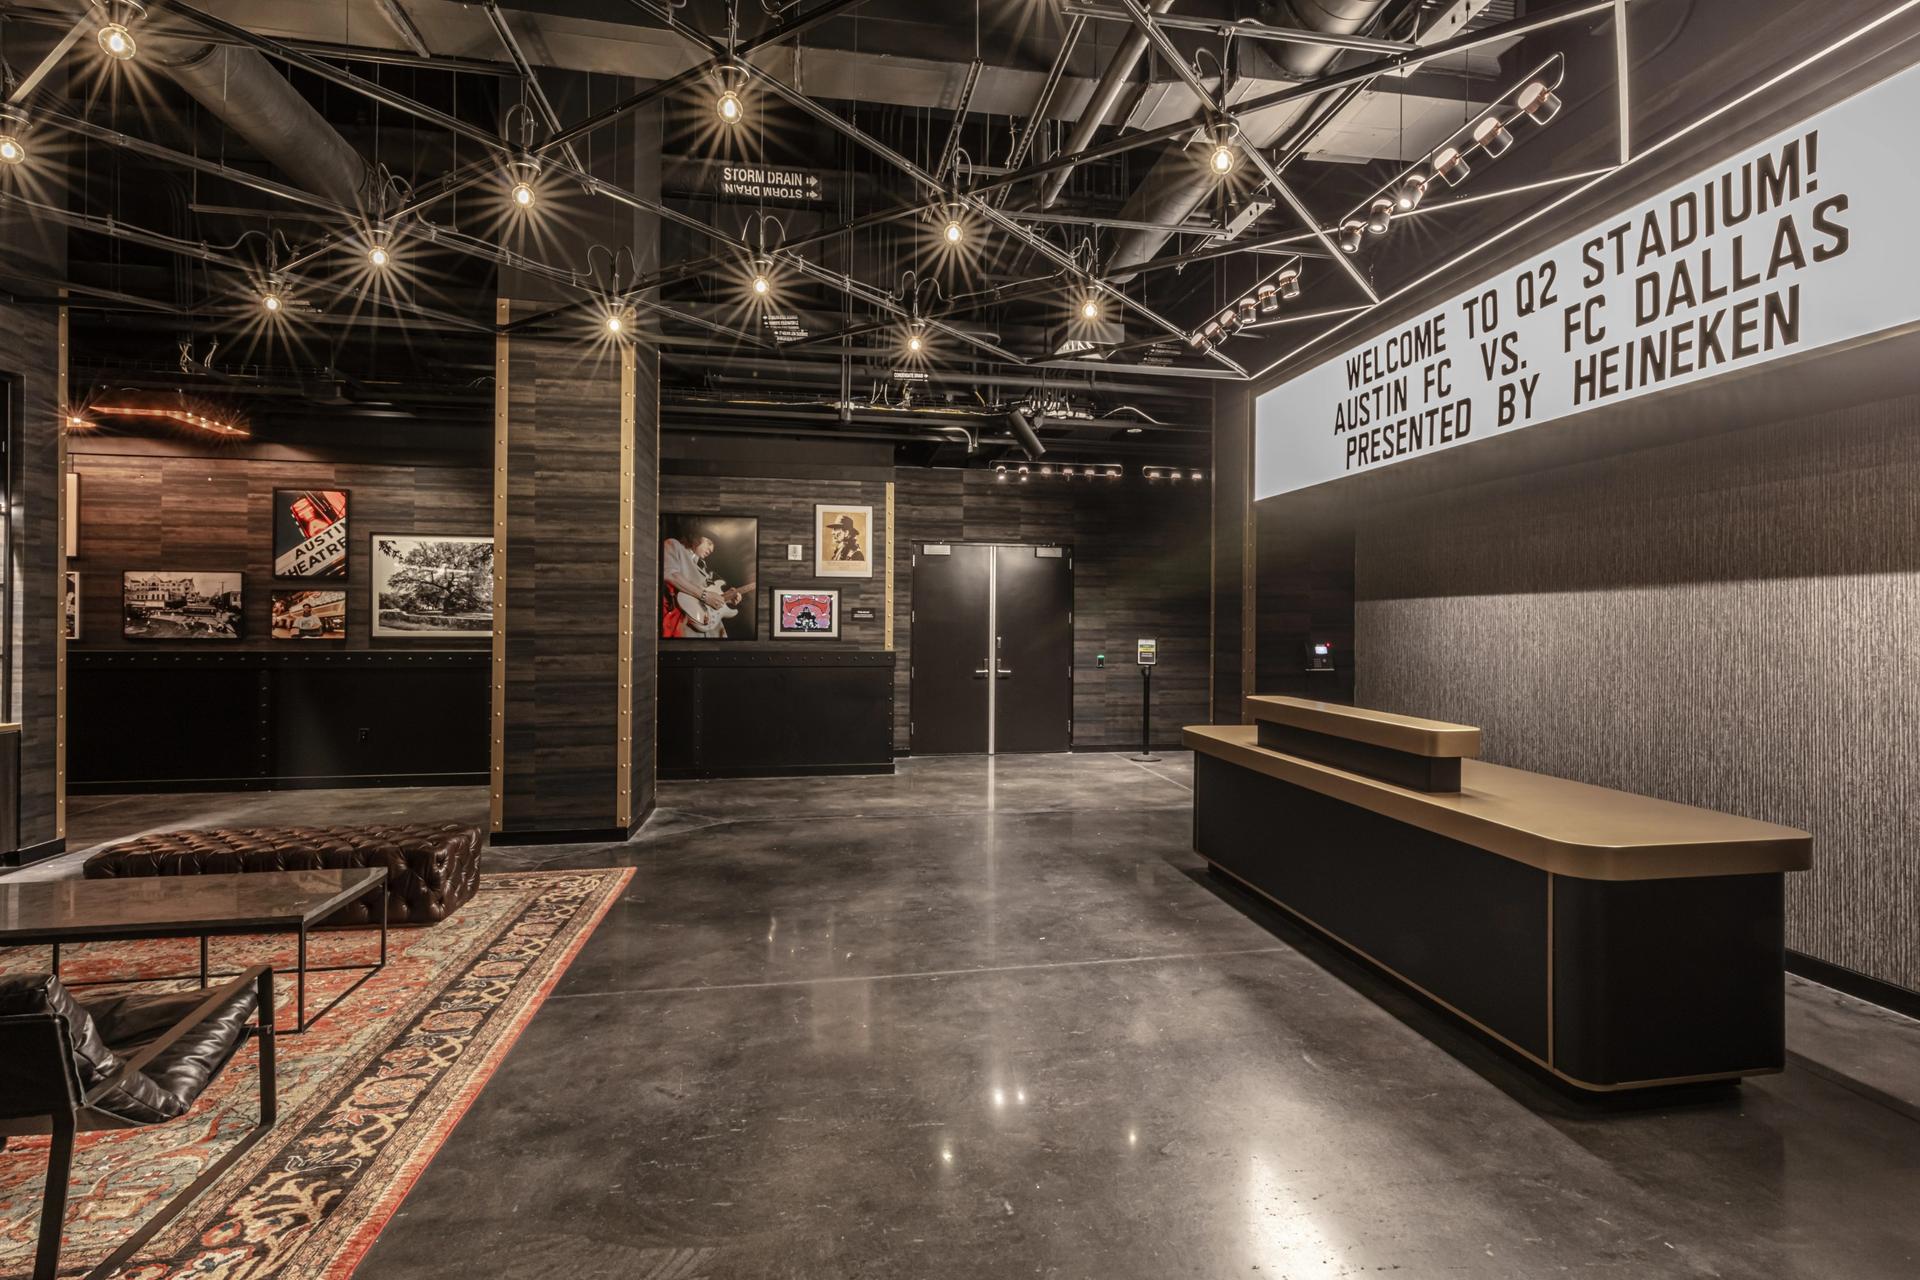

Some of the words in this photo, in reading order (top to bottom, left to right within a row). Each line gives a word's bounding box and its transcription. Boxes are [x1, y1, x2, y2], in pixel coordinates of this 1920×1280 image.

[723, 167, 764, 183] STORM
[767, 171, 803, 186] DRAIN
[724, 183, 760, 197] DRAIN
[763, 186, 803, 199] STORM
[1346, 313, 1447, 391] WELCOME
[1463, 289, 1498, 339] TO
[1516, 261, 1558, 317] Q2
[1582, 129, 1818, 289] STADIUM!
[1334, 375, 1408, 436] AUSTIN
[1423, 358, 1452, 403] FC
[1481, 331, 1527, 382] VS.
[1564, 294, 1606, 353] FC
[1635, 193, 1849, 328] DALLAS
[1346, 397, 1472, 470] PRESENTED
[1498, 373, 1540, 428] BY
[1573, 283, 1800, 406] HEINEKEN
